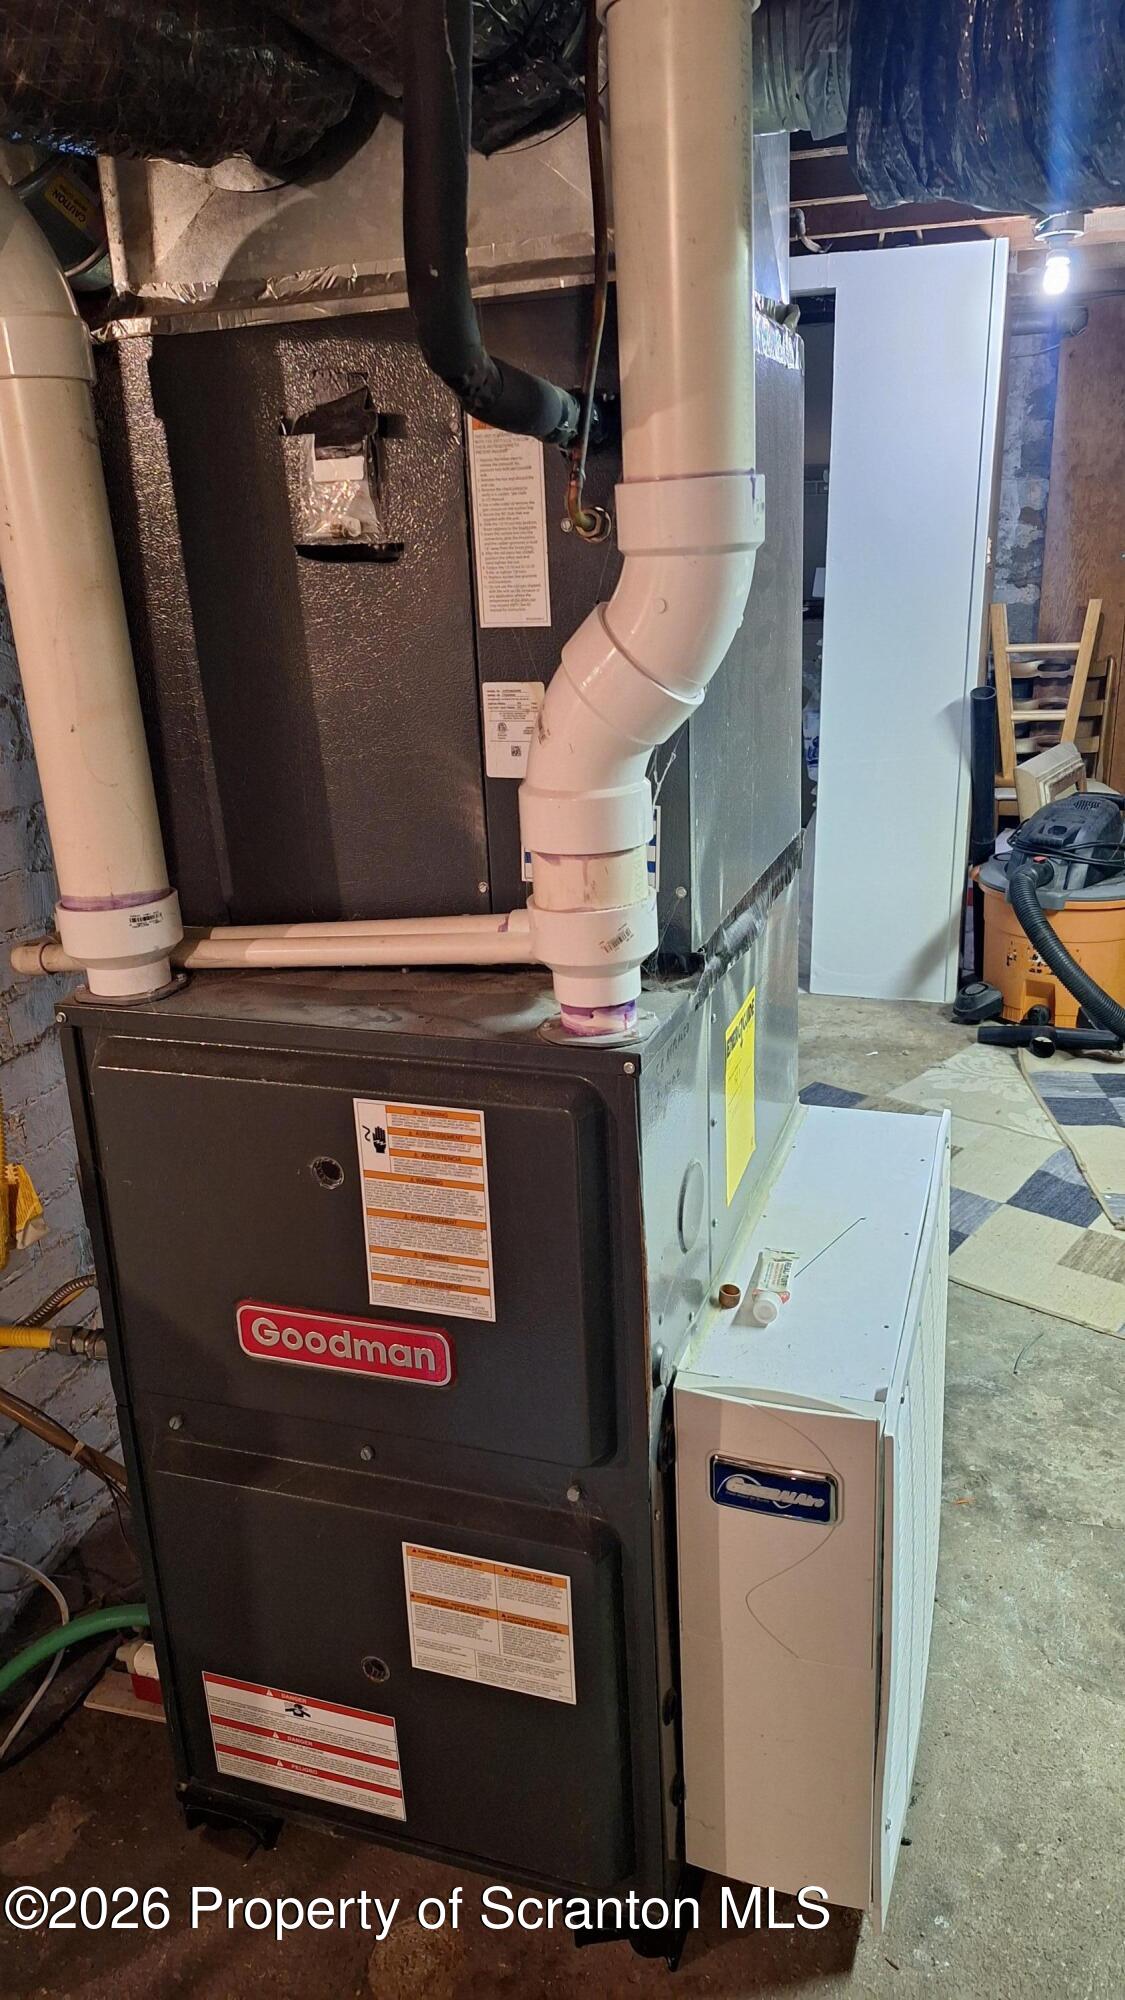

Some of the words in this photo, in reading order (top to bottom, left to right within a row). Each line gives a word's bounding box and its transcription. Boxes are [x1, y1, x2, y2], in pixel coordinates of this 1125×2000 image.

[52, 190, 86, 222] CAUTION
[420, 1110, 448, 1119] WARNING
[415, 1131, 464, 1142] AVERTISSEMENT
[420, 1153, 462, 1163] ADVERTENCIA
[416, 1178, 444, 1187] WARNING
[410, 1215, 458, 1226] AVERTISSEMENT
[416, 1253, 450, 1262] WARNING
[416, 1281, 463, 1291] AVERTISSEMENT
[251, 1317, 435, 1372] Goodman
[281, 1693, 307, 1704] DANGER
[287, 1736, 313, 1747] DANGER
[291, 1764, 318, 1776] PELIGRO
